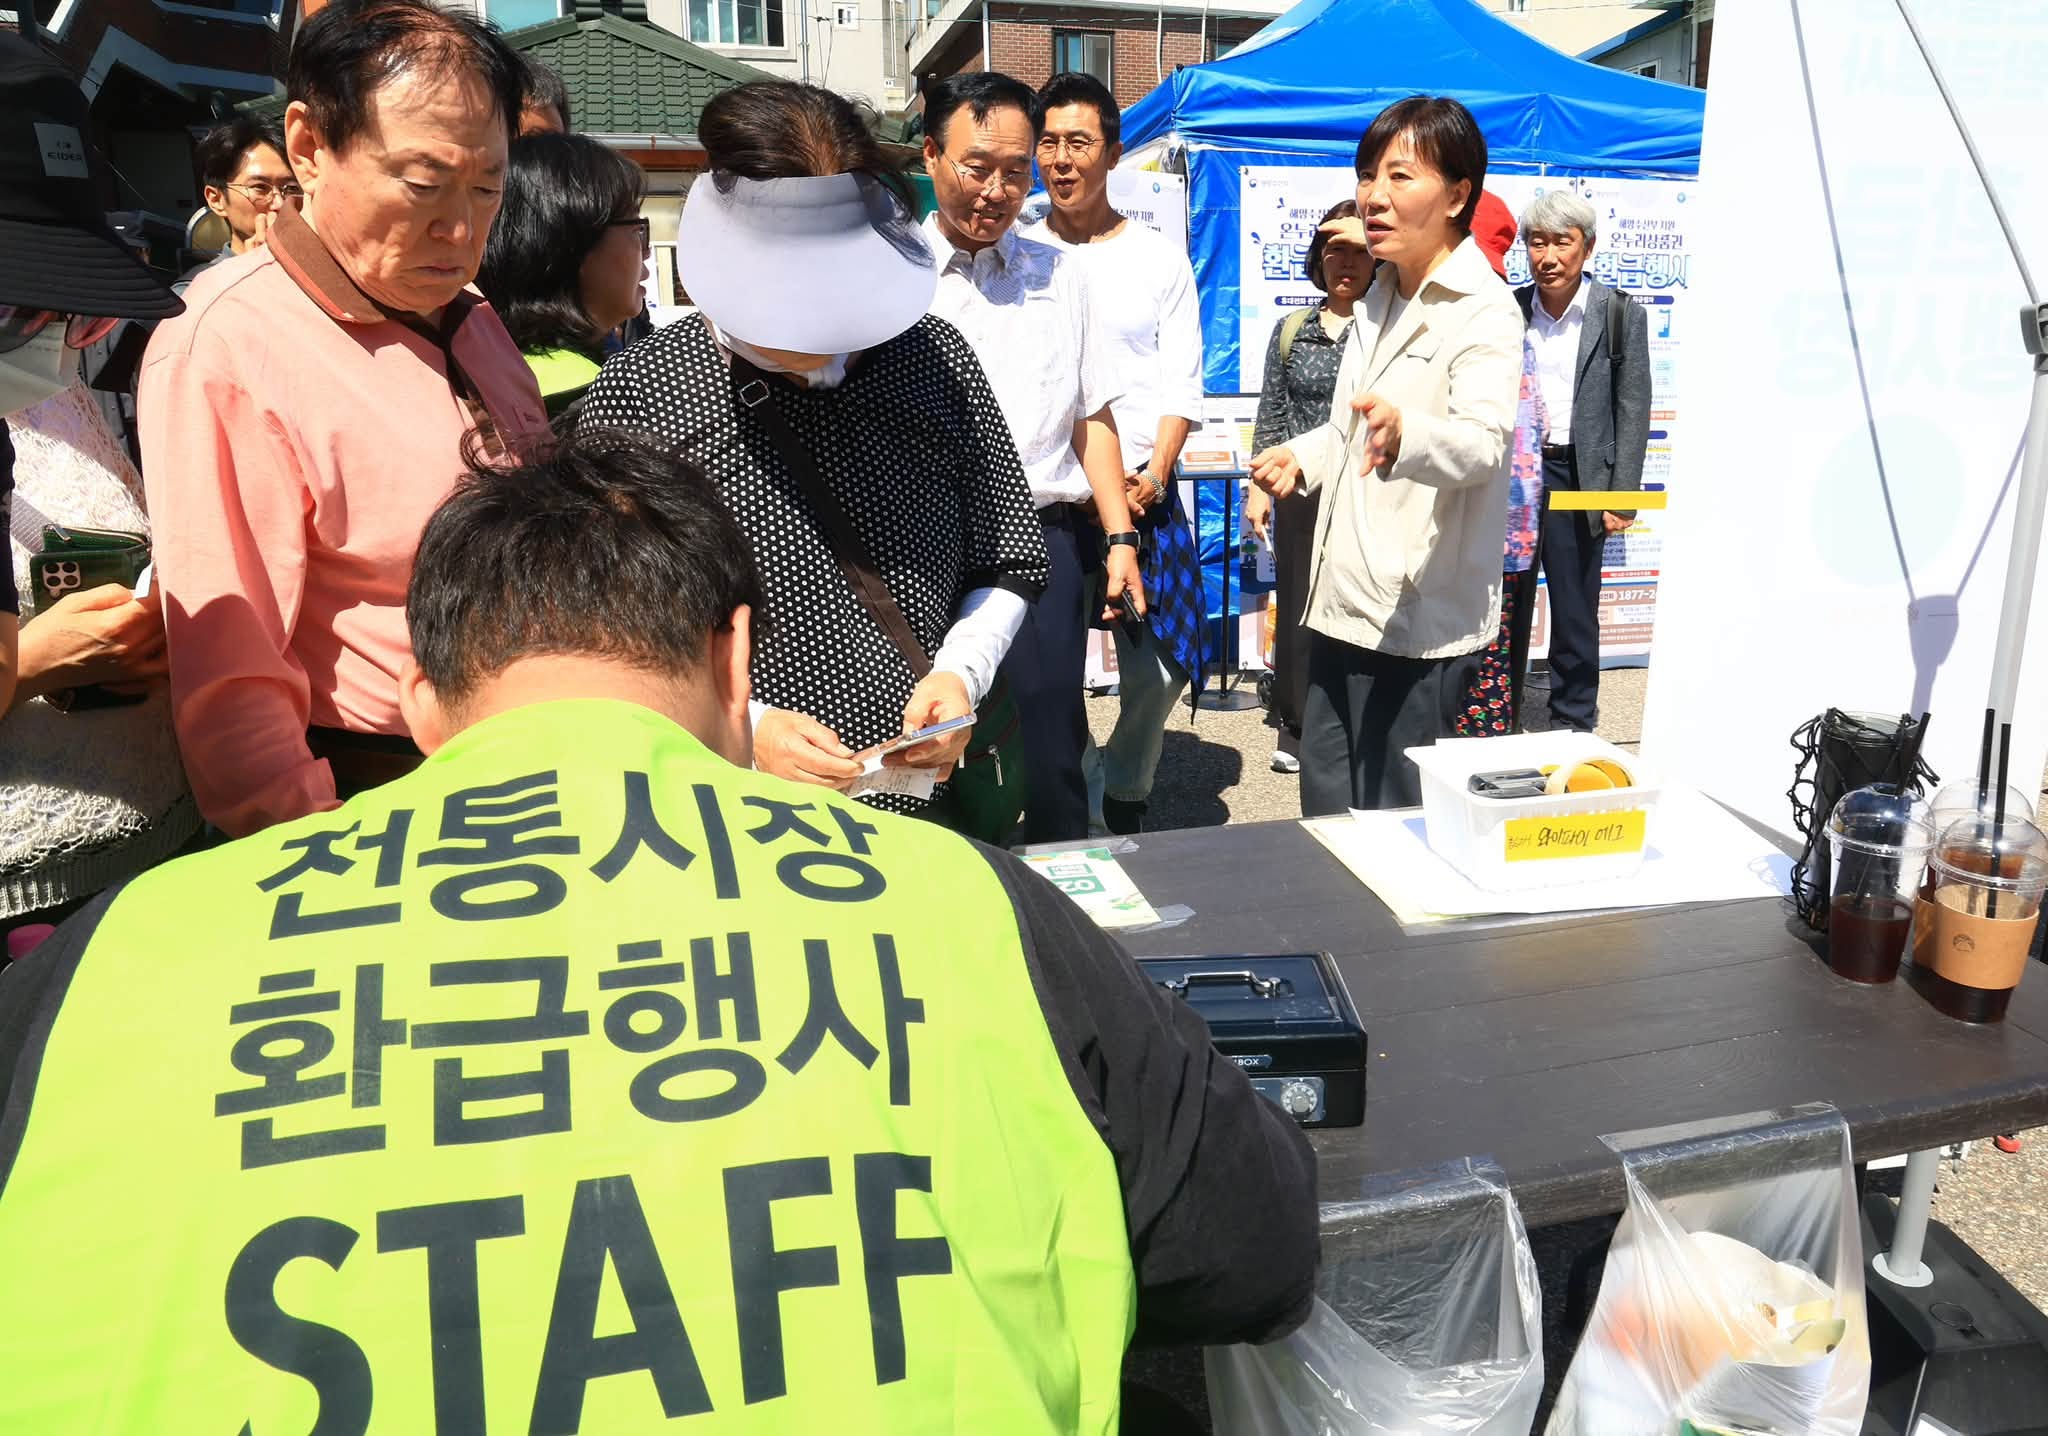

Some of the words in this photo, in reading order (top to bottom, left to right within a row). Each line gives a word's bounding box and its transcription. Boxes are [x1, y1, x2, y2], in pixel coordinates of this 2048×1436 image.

[48, 151, 82, 161] EIDER
[1290, 208, 1330, 219] 해양수산
[1619, 219, 1658, 230] 해양수산부
[1660, 220, 1676, 231] 지원
[1610, 232, 1683, 250] 온누리상품권
[257, 769, 888, 940] 전통시장
[214, 931, 926, 1171] 환급행사
[224, 1152, 954, 1436] STAFF
